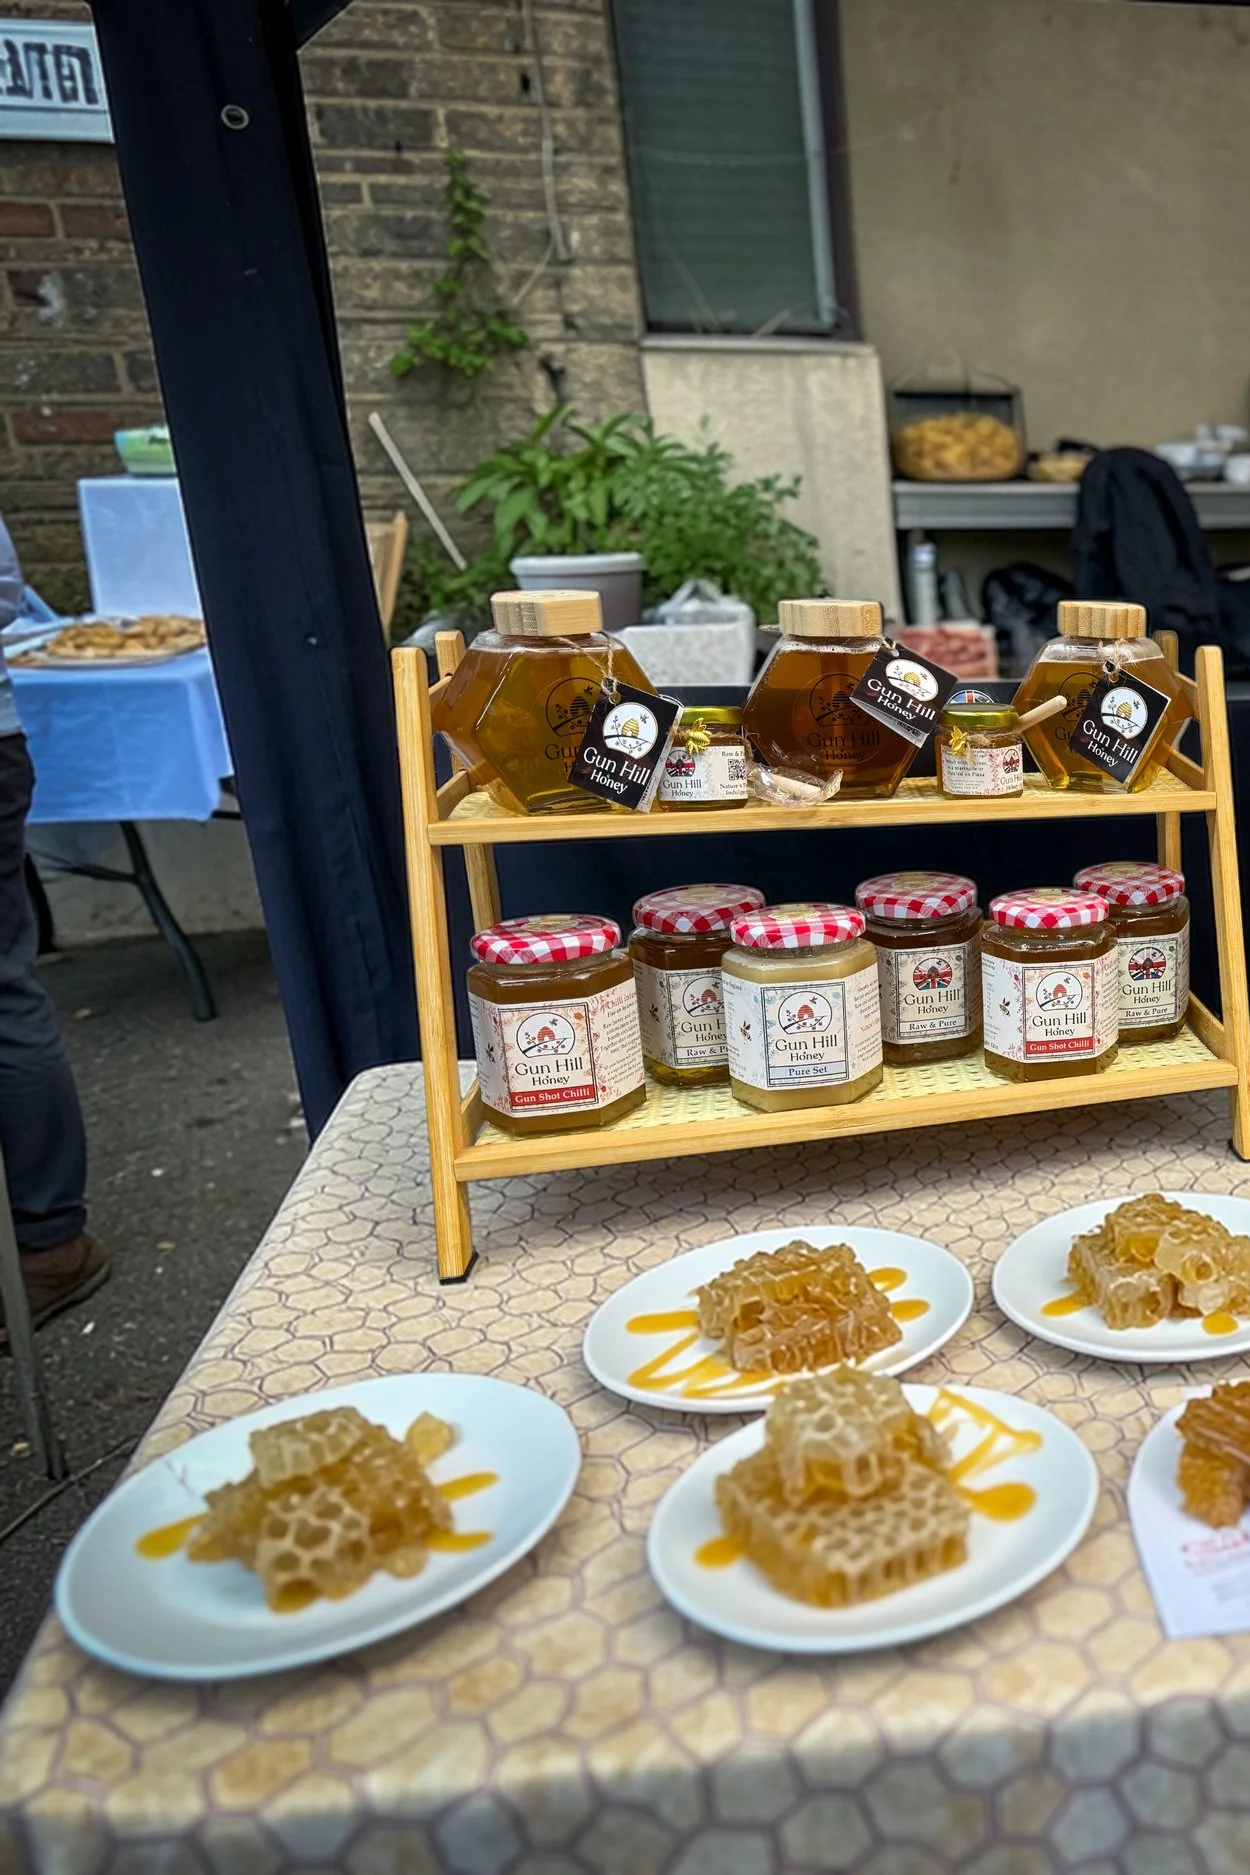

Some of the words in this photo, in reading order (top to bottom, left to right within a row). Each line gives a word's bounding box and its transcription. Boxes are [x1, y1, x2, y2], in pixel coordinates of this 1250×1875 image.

[867, 678, 902, 704] Gun
[906, 698, 936, 721] Hill
[877, 694, 916, 721] Honey
[807, 733, 846, 748] Gun
[850, 731, 880, 748] Hill
[1083, 719, 1111, 747] Gun
[1112, 738, 1139, 764] Hill
[1087, 740, 1119, 768] Honey
[584, 747, 617, 773] Gun
[619, 761, 651, 786] Hill
[590, 769, 628, 795] Honey
[662, 779, 683, 790] Gun
[685, 778, 702, 789] Hill
[671, 789, 694, 798] Honey
[1122, 984, 1149, 996] Gun
[1152, 980, 1171, 993] Hill
[904, 994, 934, 1006] Gun
[938, 988, 960, 1003] Hill
[1133, 995, 1161, 1005] Honey
[917, 1005, 949, 1015] Honey
[1125, 1010, 1143, 1018] Raw
[1152, 1007, 1168, 1015] Pure
[909, 1023, 928, 1031] Raw
[938, 1019, 957, 1028] Pure
[1032, 1015, 1061, 1027] Gun
[1065, 1011, 1087, 1025] Hill
[681, 1021, 712, 1033] Gun
[1045, 1027, 1076, 1037] Honey
[775, 1038, 808, 1052] Gun
[812, 1034, 838, 1048] Hill
[1029, 1043, 1047, 1052] Gun
[1048, 1041, 1067, 1050] Shot
[1068, 1039, 1090, 1048] Chilli
[686, 1048, 707, 1057] Raw
[790, 1051, 825, 1062] Honey
[515, 1062, 551, 1076] Gun
[555, 1057, 584, 1073] Hill
[788, 1067, 811, 1077] Pure
[812, 1066, 828, 1075] Set
[532, 1074, 570, 1087] Honey
[515, 1095, 536, 1104] Gun
[538, 1092, 560, 1102] Shot
[562, 1089, 591, 1100] Chilli
